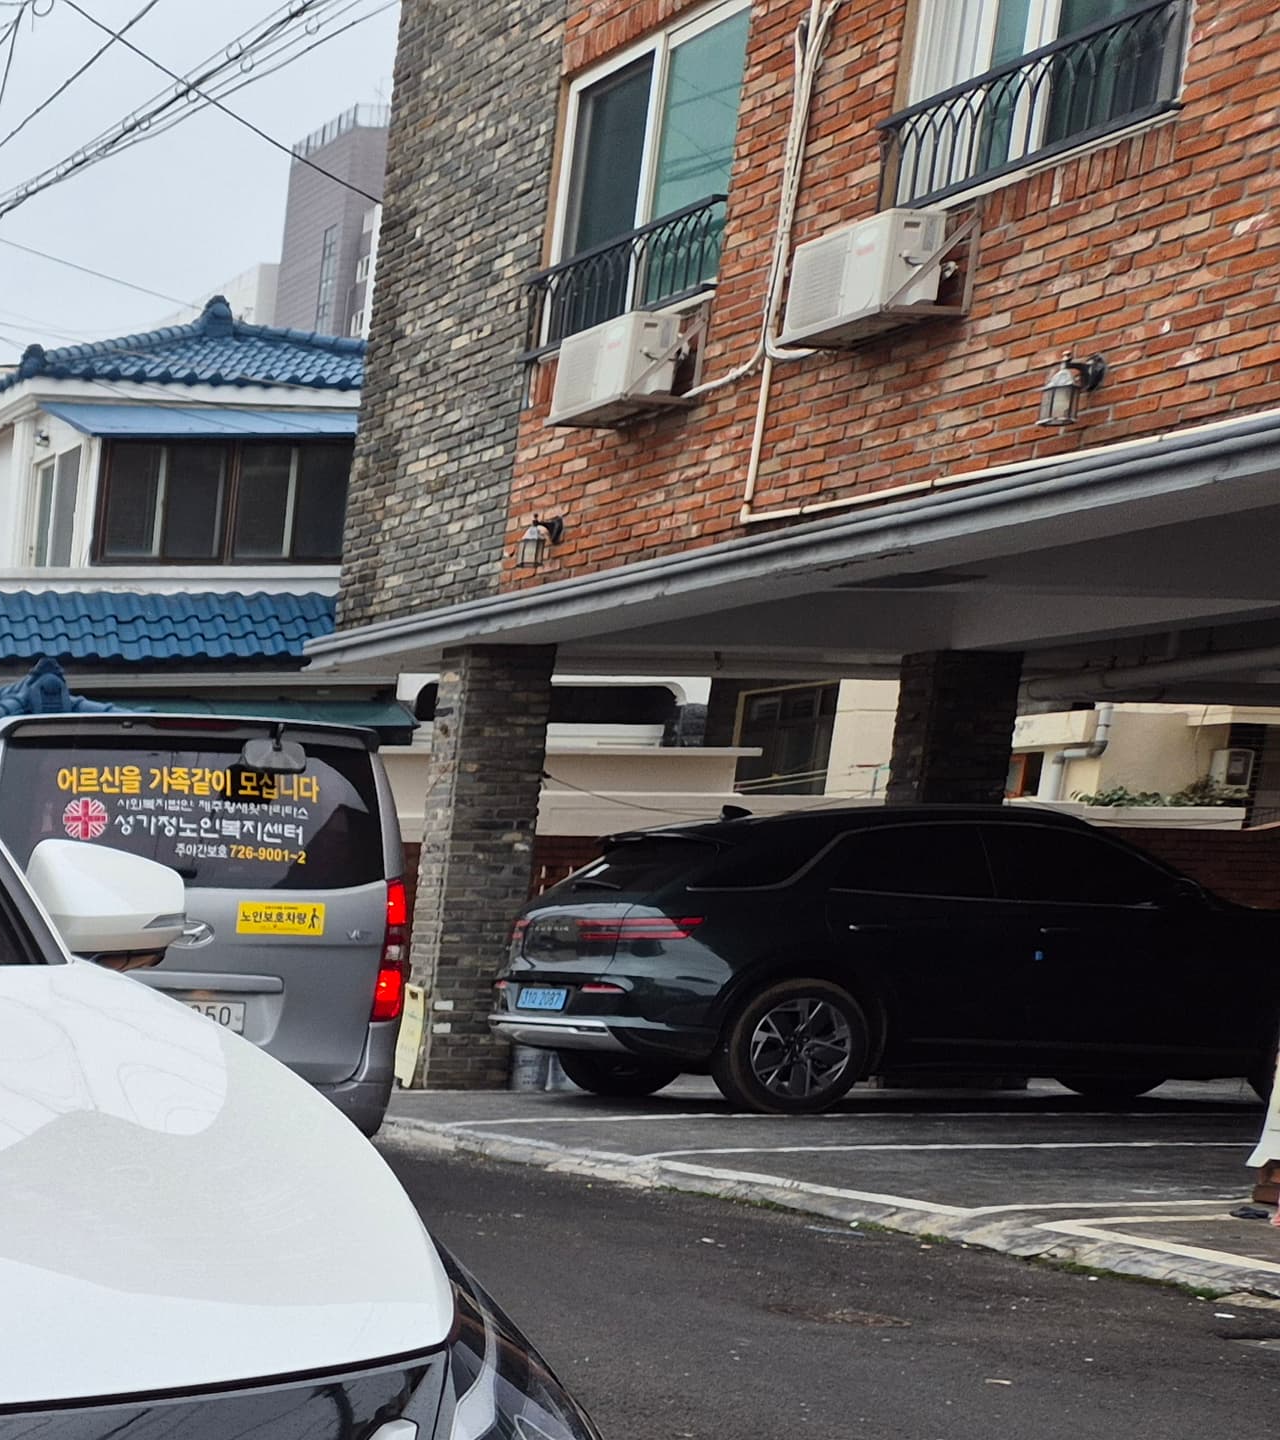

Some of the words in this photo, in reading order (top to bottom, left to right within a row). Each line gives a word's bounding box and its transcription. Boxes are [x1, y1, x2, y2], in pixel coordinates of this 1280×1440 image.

[57, 766, 142, 795] 어르신을
[148, 766, 232, 797] 가족같이
[238, 772, 320, 803] 모십니다
[114, 814, 304, 846] 성가정노인복지센터
[175, 843, 228, 860] 주야간보호
[229, 844, 307, 865] 726-9001~2
[240, 911, 307, 925] 노인보호차량
